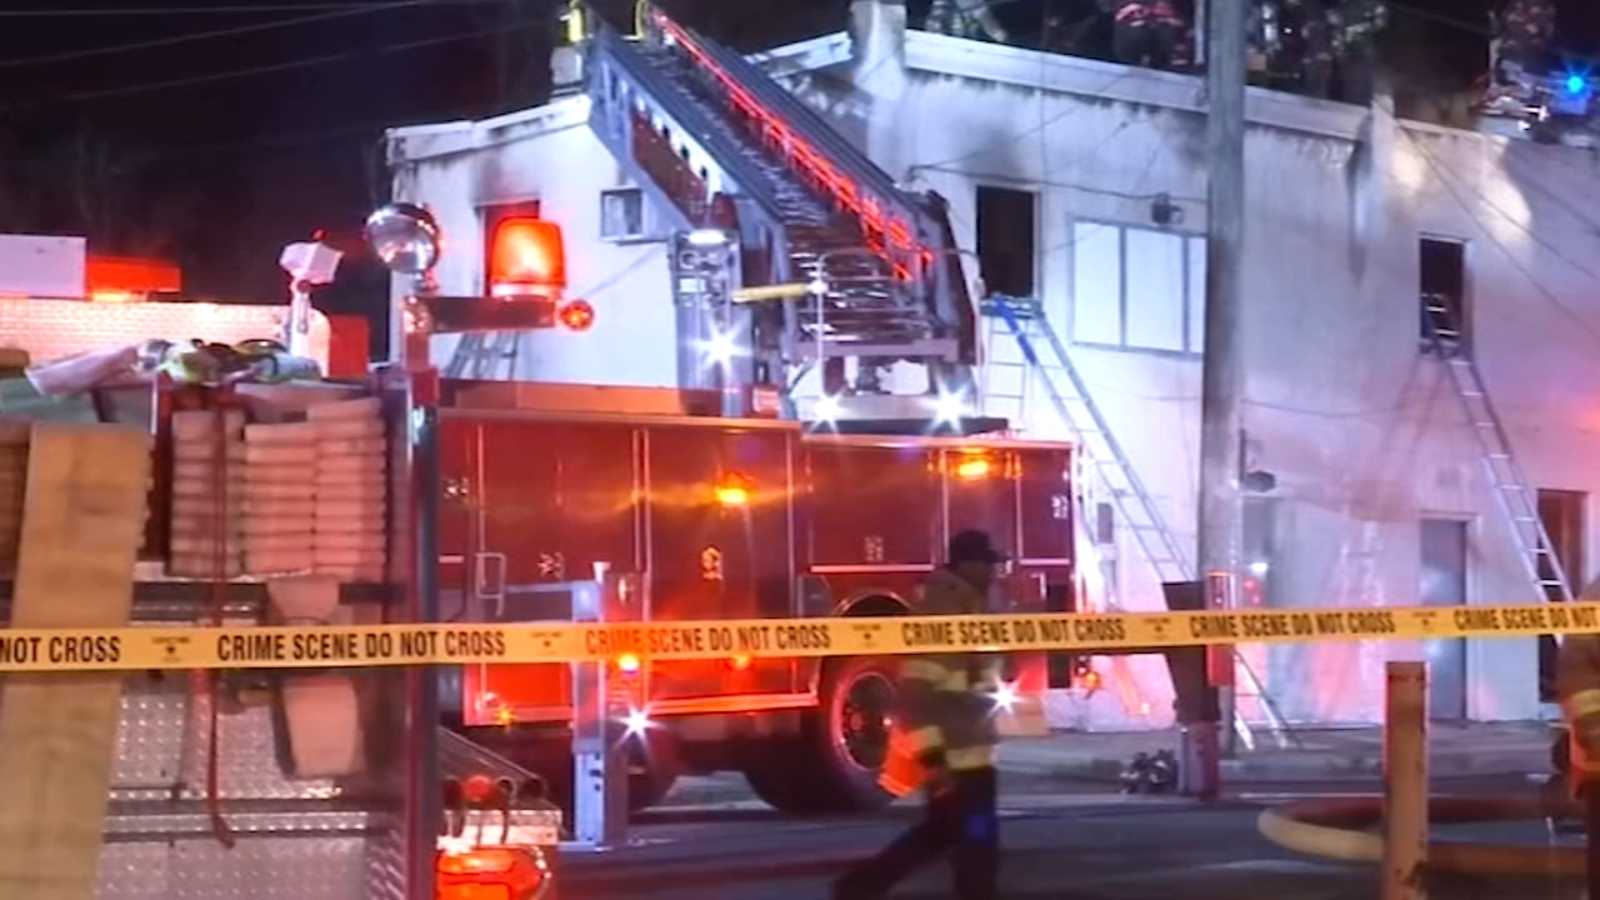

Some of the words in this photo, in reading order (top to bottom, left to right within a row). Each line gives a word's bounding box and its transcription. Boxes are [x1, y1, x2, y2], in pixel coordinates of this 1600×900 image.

[901, 622, 954, 645] CRIME
[959, 621, 1008, 644] SCENE
[1014, 620, 1035, 642] DO
[1040, 619, 1067, 642] NOT
[1075, 618, 1126, 640] CROSS
[1189, 616, 1238, 638] CRIME
[1243, 615, 1290, 637] SCENE
[1293, 614, 1313, 635] DO
[1318, 613, 1344, 635] NOT
[1348, 611, 1396, 634] CROSS
[1454, 610, 1500, 631] CRIME
[1504, 609, 1546, 630] SCENE
[1550, 608, 1568, 628] DO
[1573, 607, 1599, 627] NOT
[49, 636, 121, 663] CROSS
[217, 635, 285, 661] CRIME
[293, 633, 358, 660] SCENE
[365, 632, 392, 658] DO
[400, 632, 438, 658] NOT
[446, 631, 506, 657] CROSS
[586, 629, 642, 654] CRIME
[652, 628, 704, 653] SCENE
[709, 627, 732, 651] DO
[739, 626, 771, 650] NOT
[776, 625, 831, 649] CROSS
